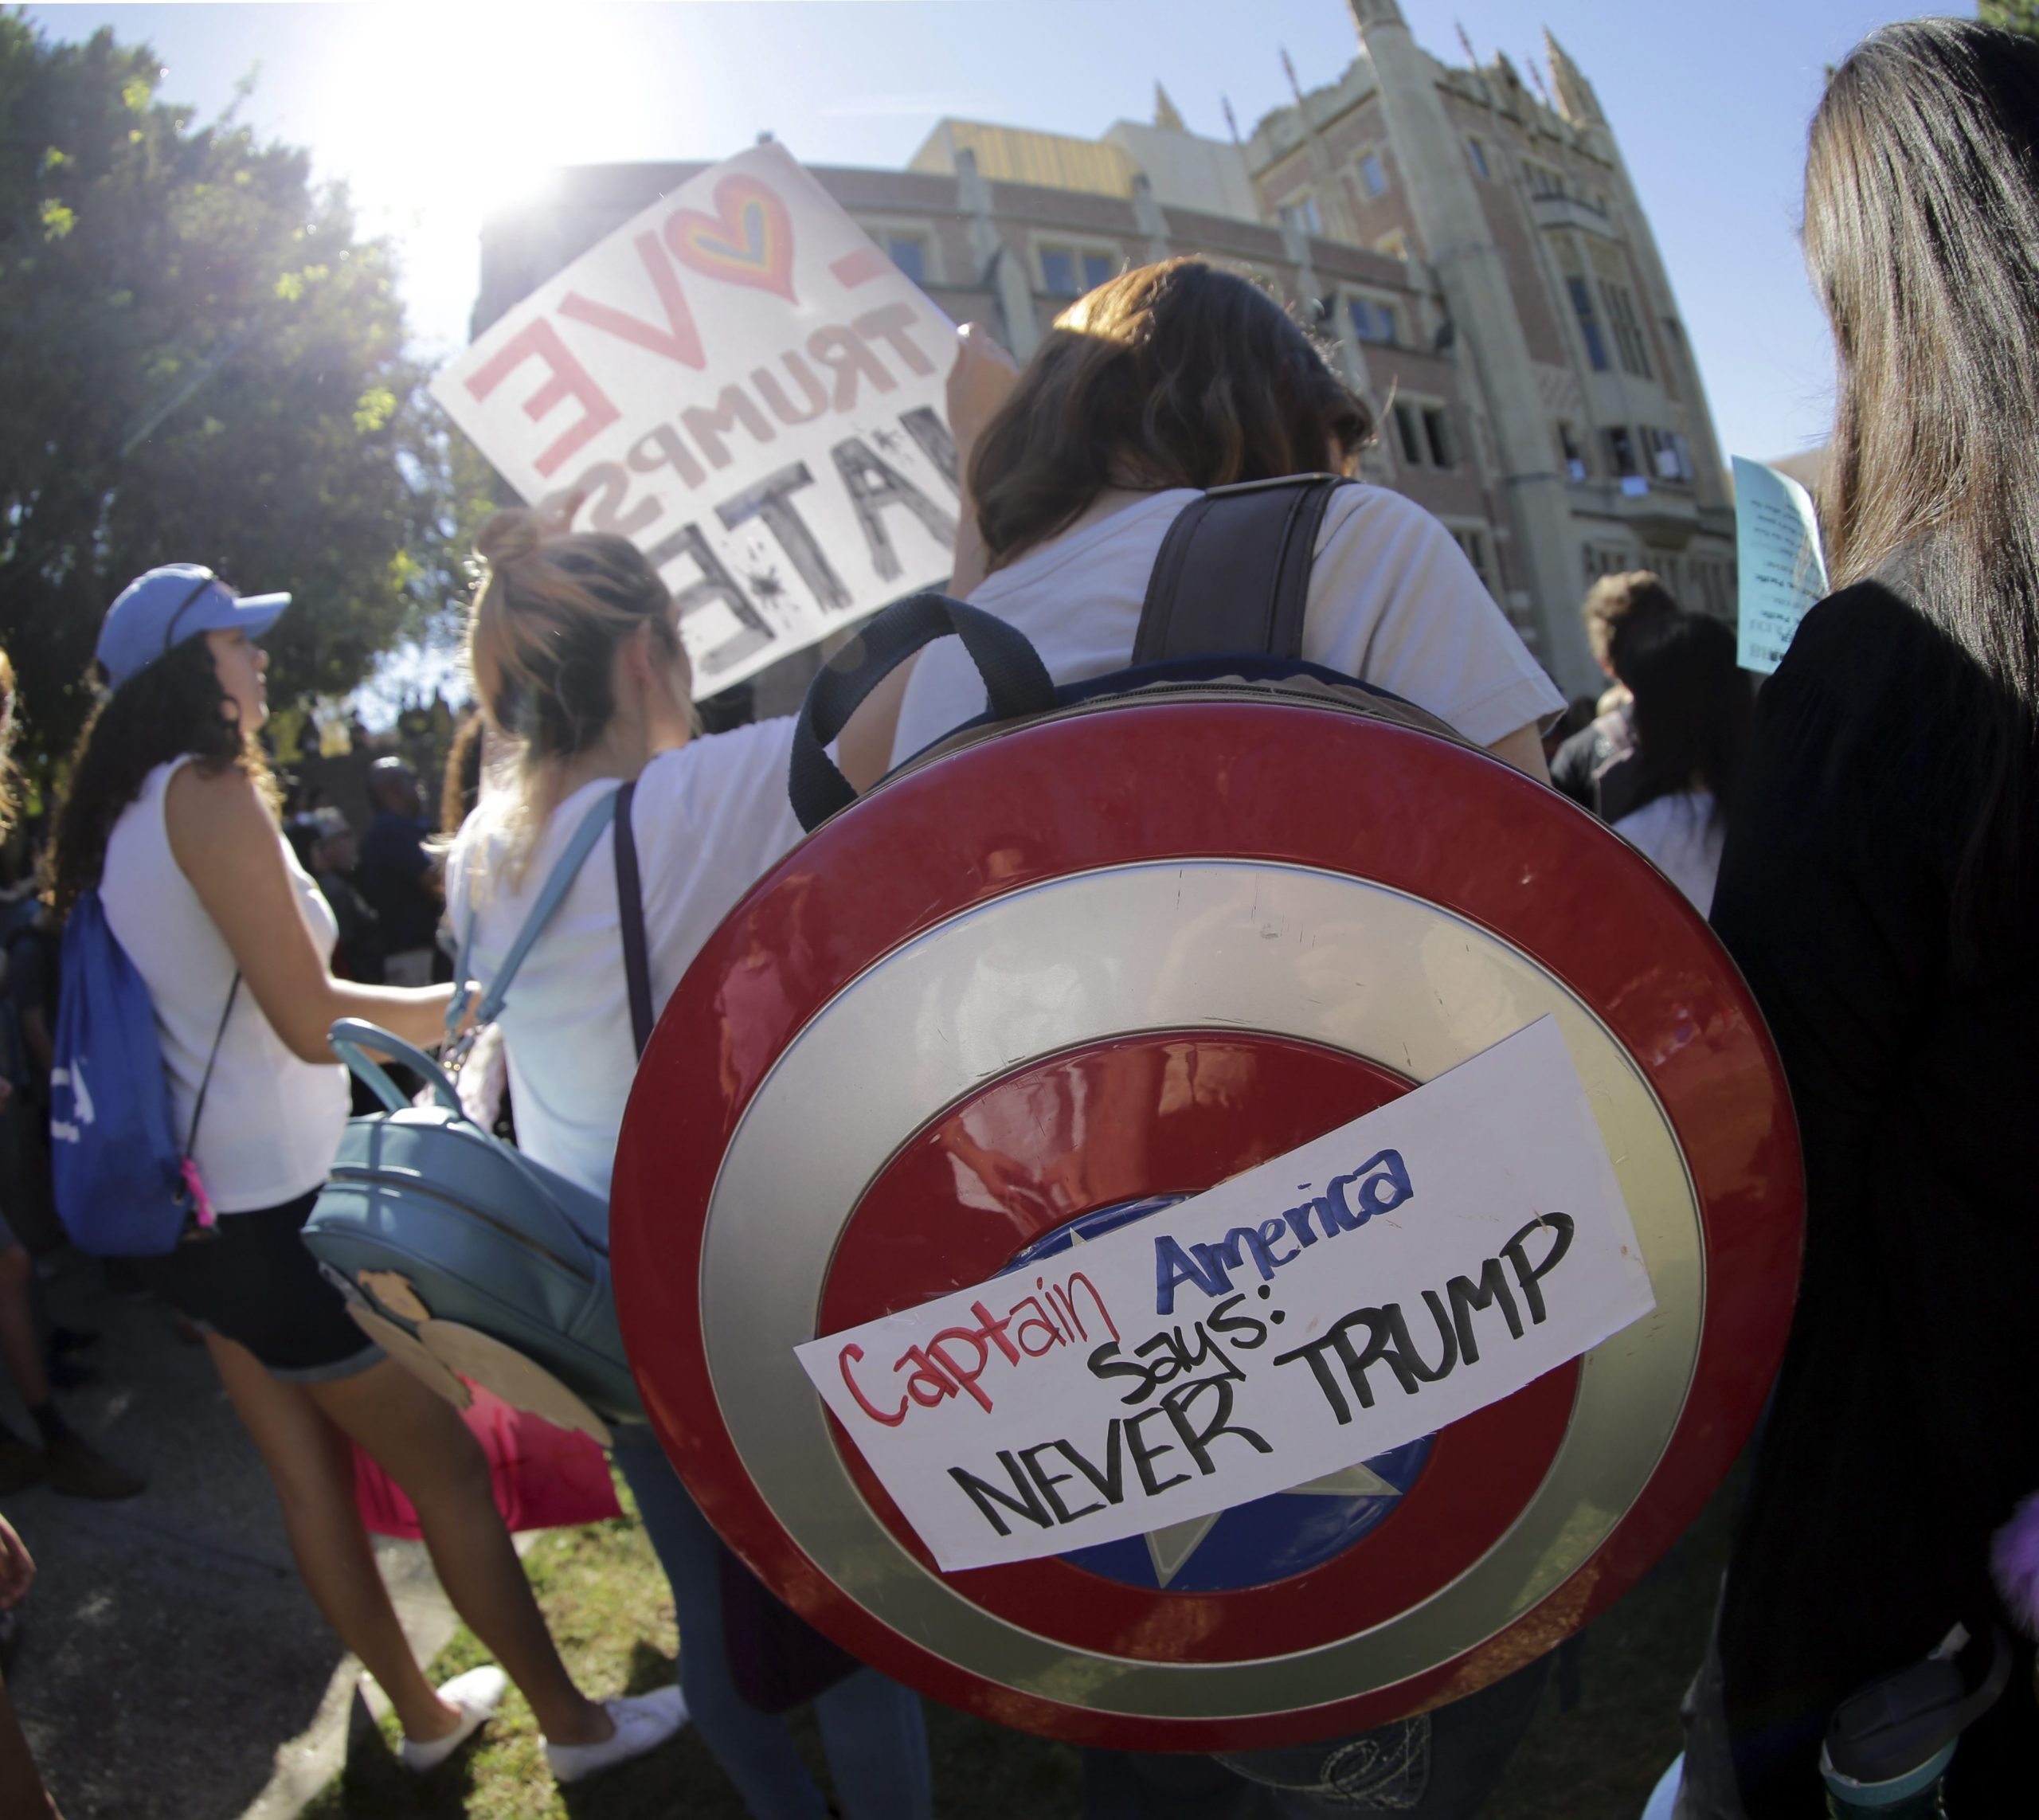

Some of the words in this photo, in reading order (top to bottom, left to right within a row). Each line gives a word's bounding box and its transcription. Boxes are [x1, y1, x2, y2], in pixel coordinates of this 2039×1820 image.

[839, 1272, 1120, 1427] Captain
[1155, 1149, 1414, 1315] America
[947, 1380, 1274, 1536] NEVER
[1274, 1211, 1575, 1425] TRUMP
